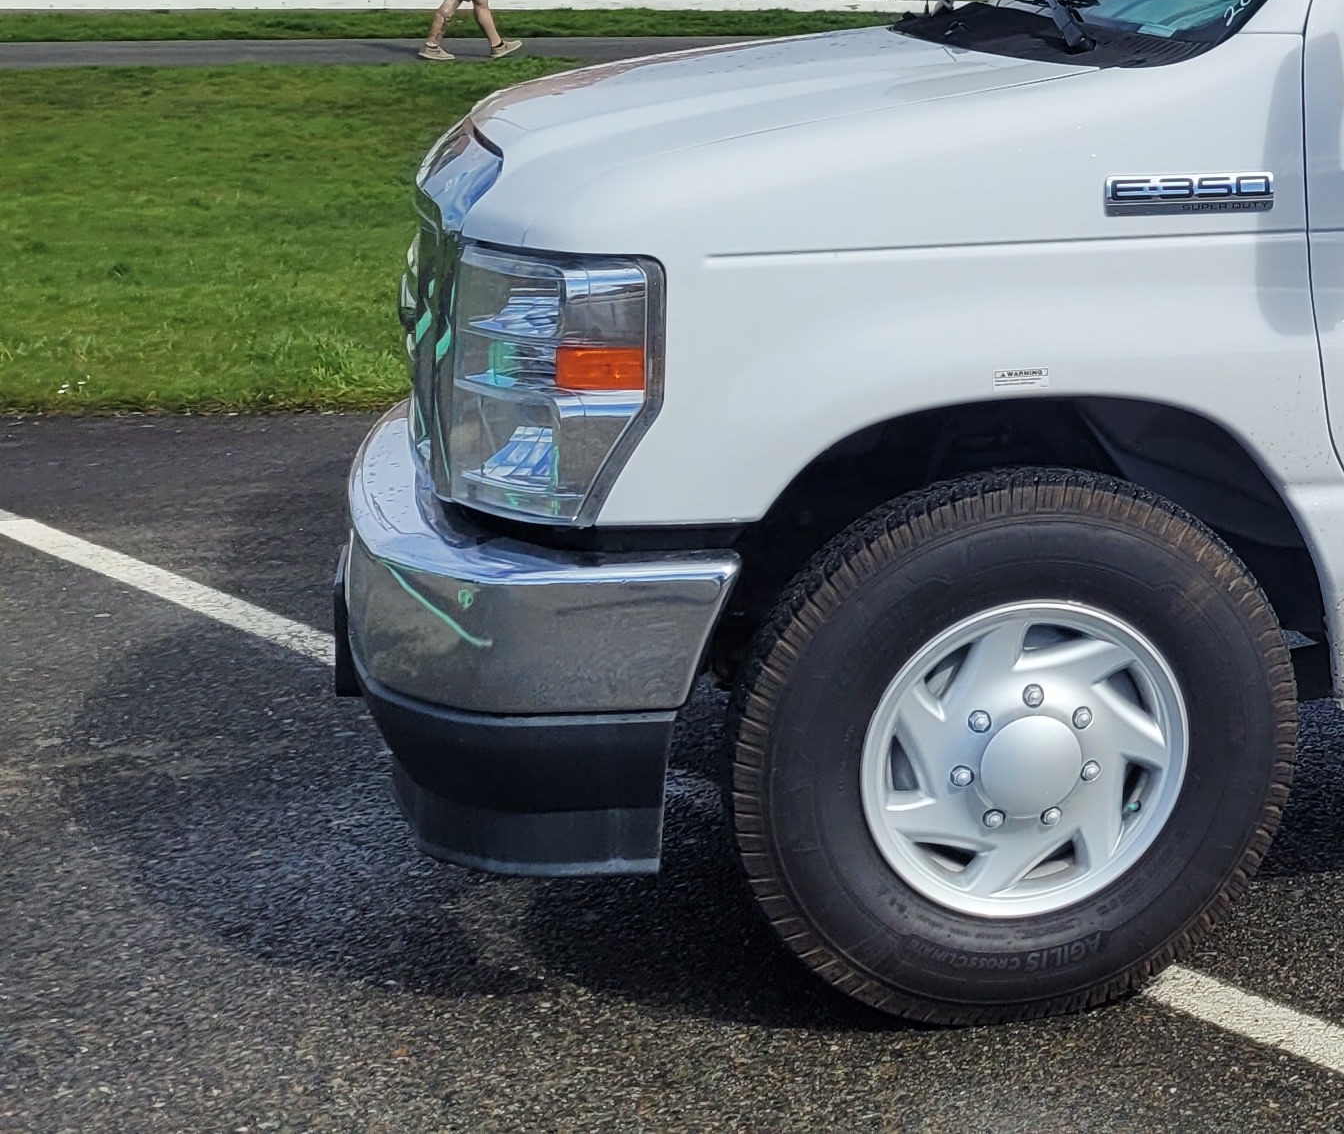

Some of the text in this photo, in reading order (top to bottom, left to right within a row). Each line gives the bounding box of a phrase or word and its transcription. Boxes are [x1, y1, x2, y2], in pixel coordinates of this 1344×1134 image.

[1111, 175, 1270, 201] E-350
[1181, 201, 1269, 212] SUPER DUTY
[1007, 369, 1043, 377] WARNING
[1025, 932, 1101, 972] AGILIS
